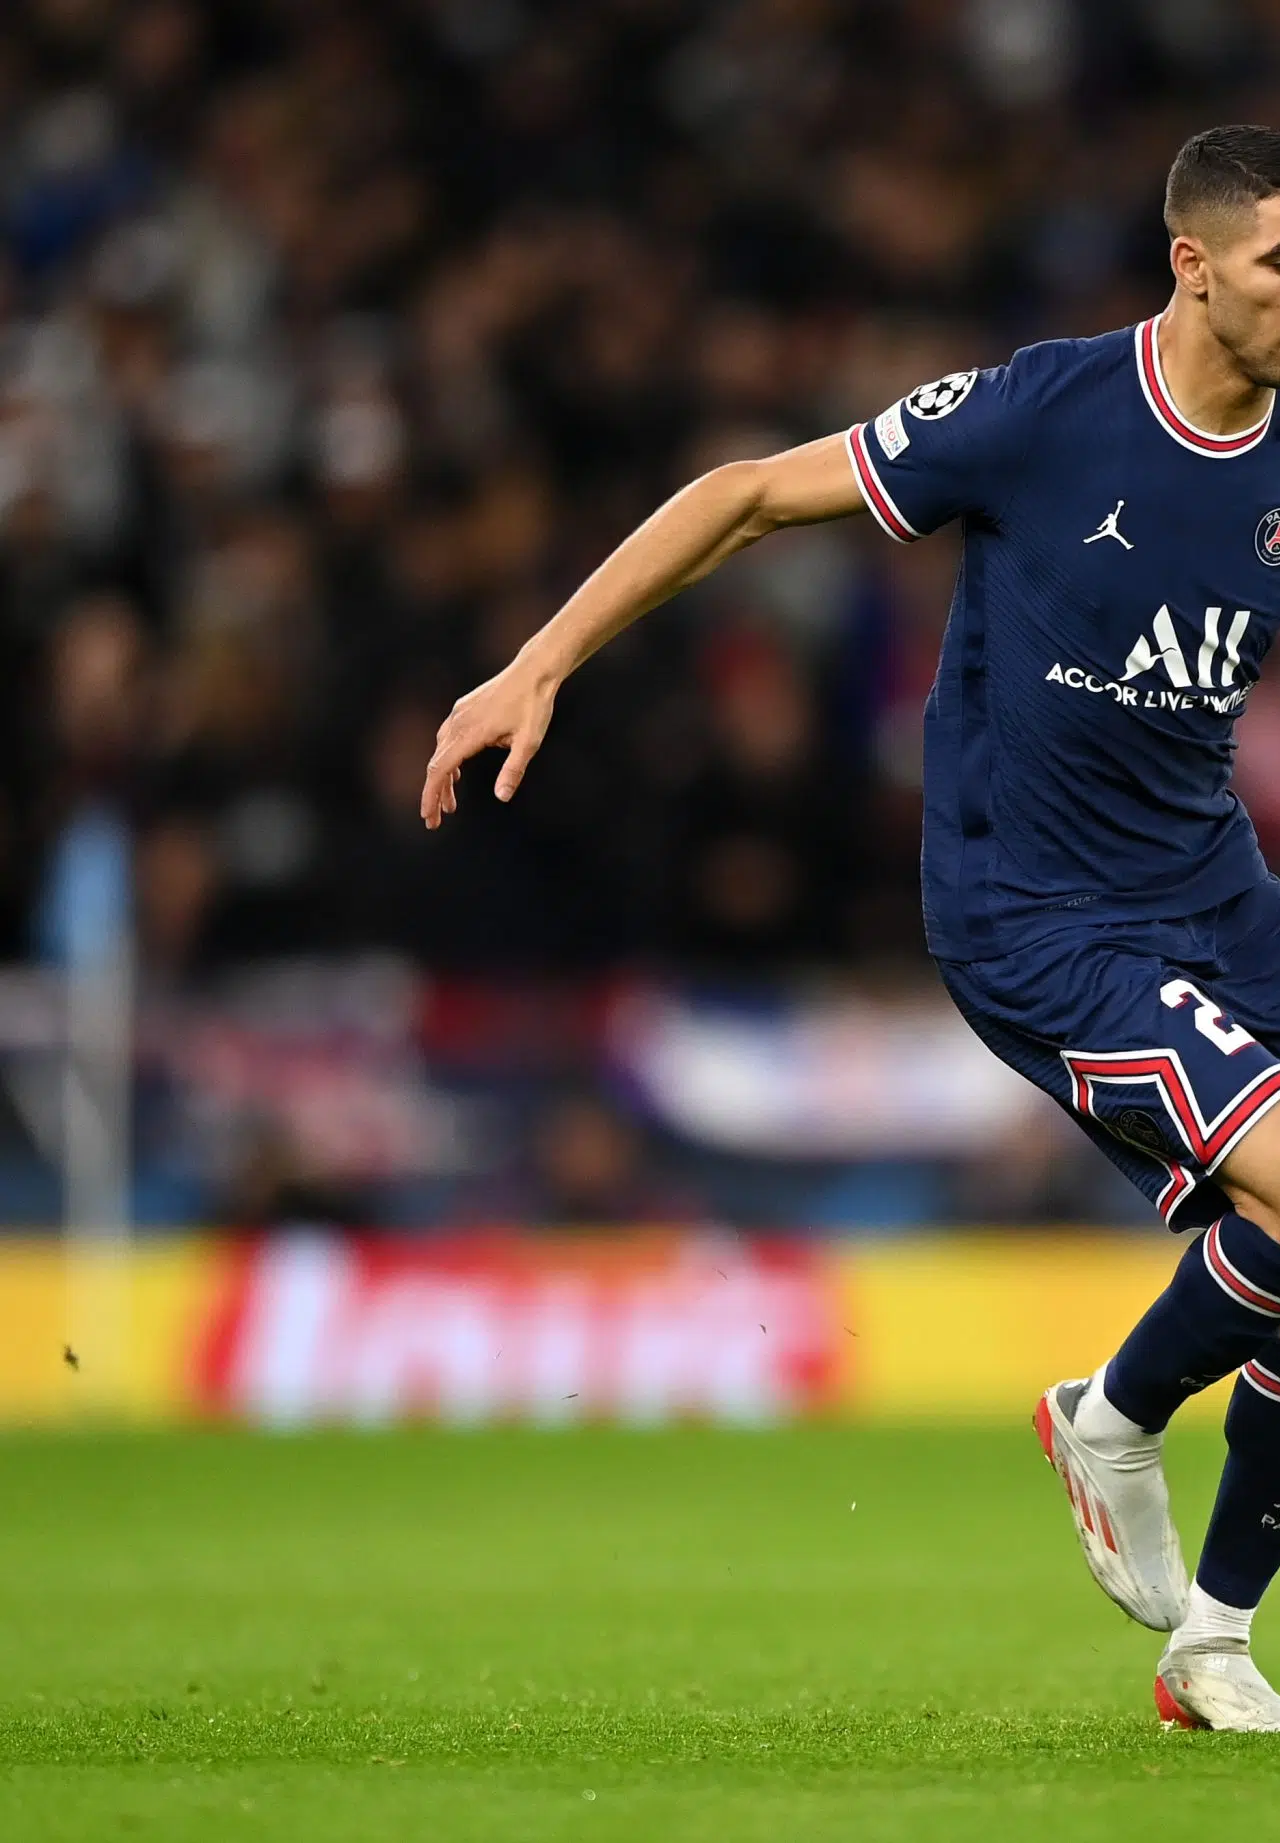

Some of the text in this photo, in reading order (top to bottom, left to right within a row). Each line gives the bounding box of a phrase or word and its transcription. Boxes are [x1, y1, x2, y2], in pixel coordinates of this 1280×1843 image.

[1045, 662, 1138, 706] ACCOR
[1144, 690, 1198, 711] LIVE
[1159, 978, 1257, 1056] 2
